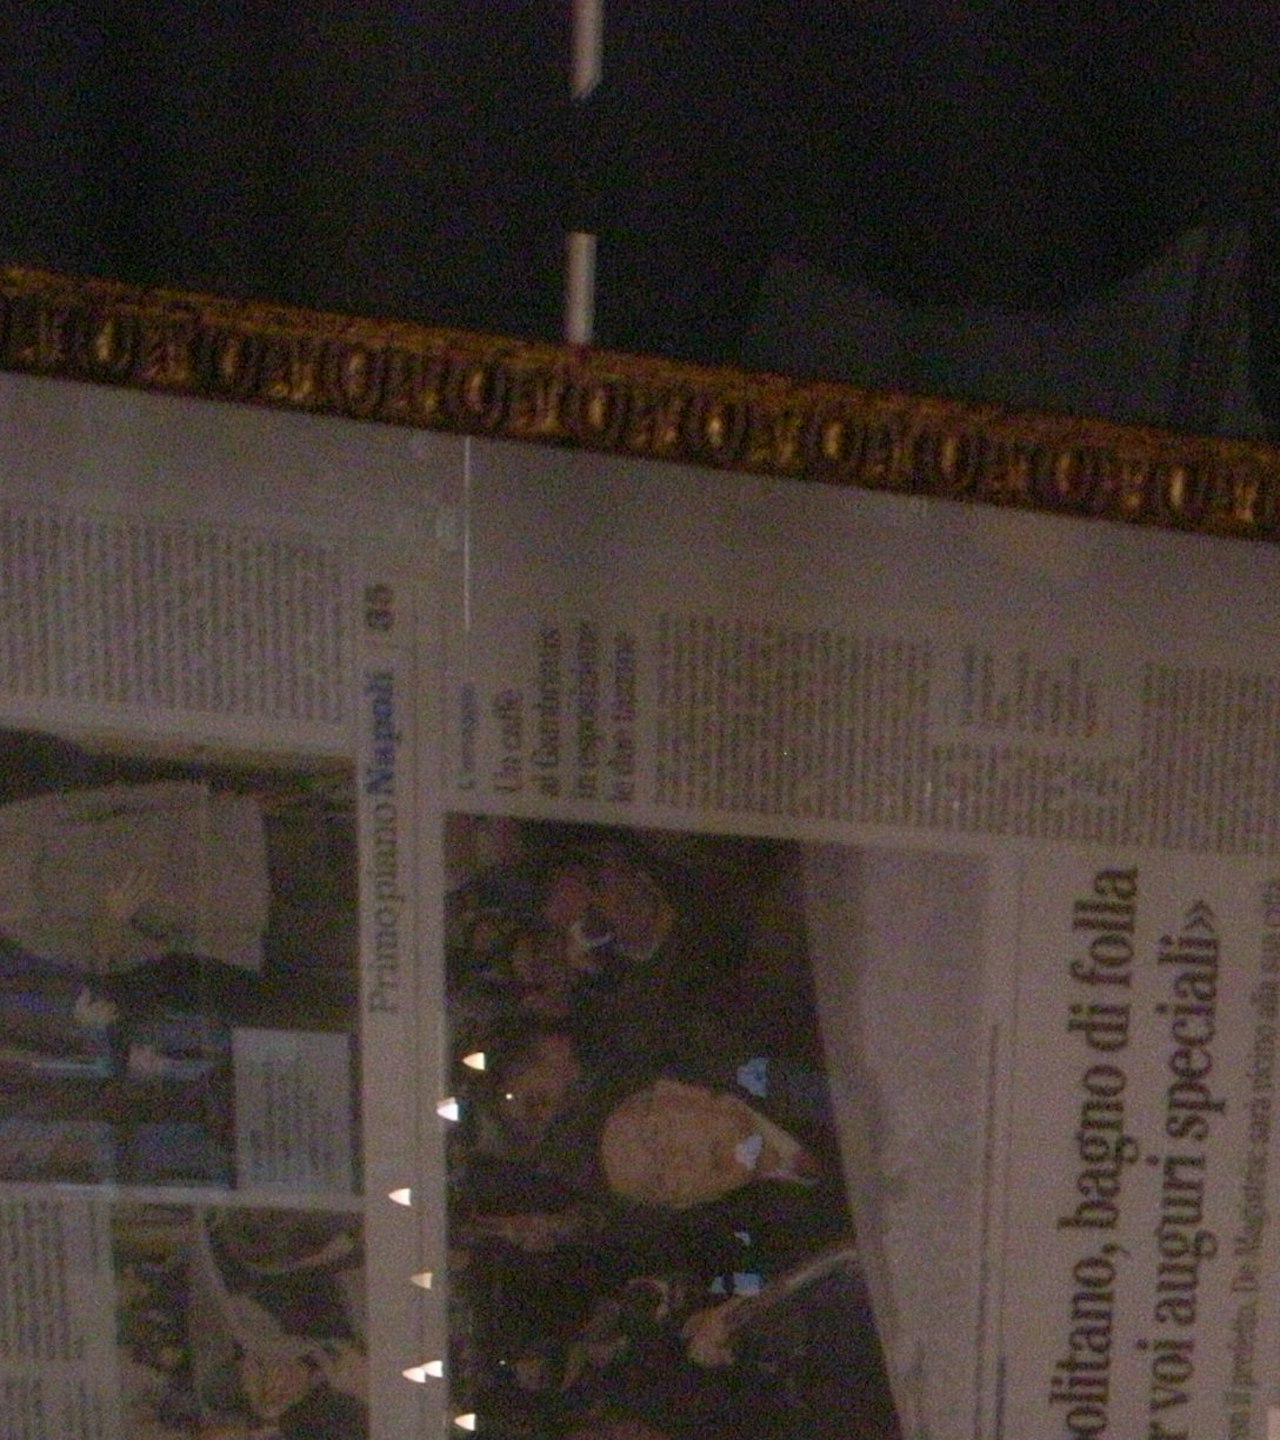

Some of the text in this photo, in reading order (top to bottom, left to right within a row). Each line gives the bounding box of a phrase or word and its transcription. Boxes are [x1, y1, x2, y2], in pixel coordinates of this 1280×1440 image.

[363, 670, 402, 797] Napoli
[1069, 865, 1139, 988] folla
[1065, 1004, 1132, 1052] di
[1156, 898, 1224, 1142] speciali»
[1058, 1065, 1138, 1230] bagno
[1146, 1154, 1218, 1326] auguri
[1136, 1337, 1194, 1410] voi
